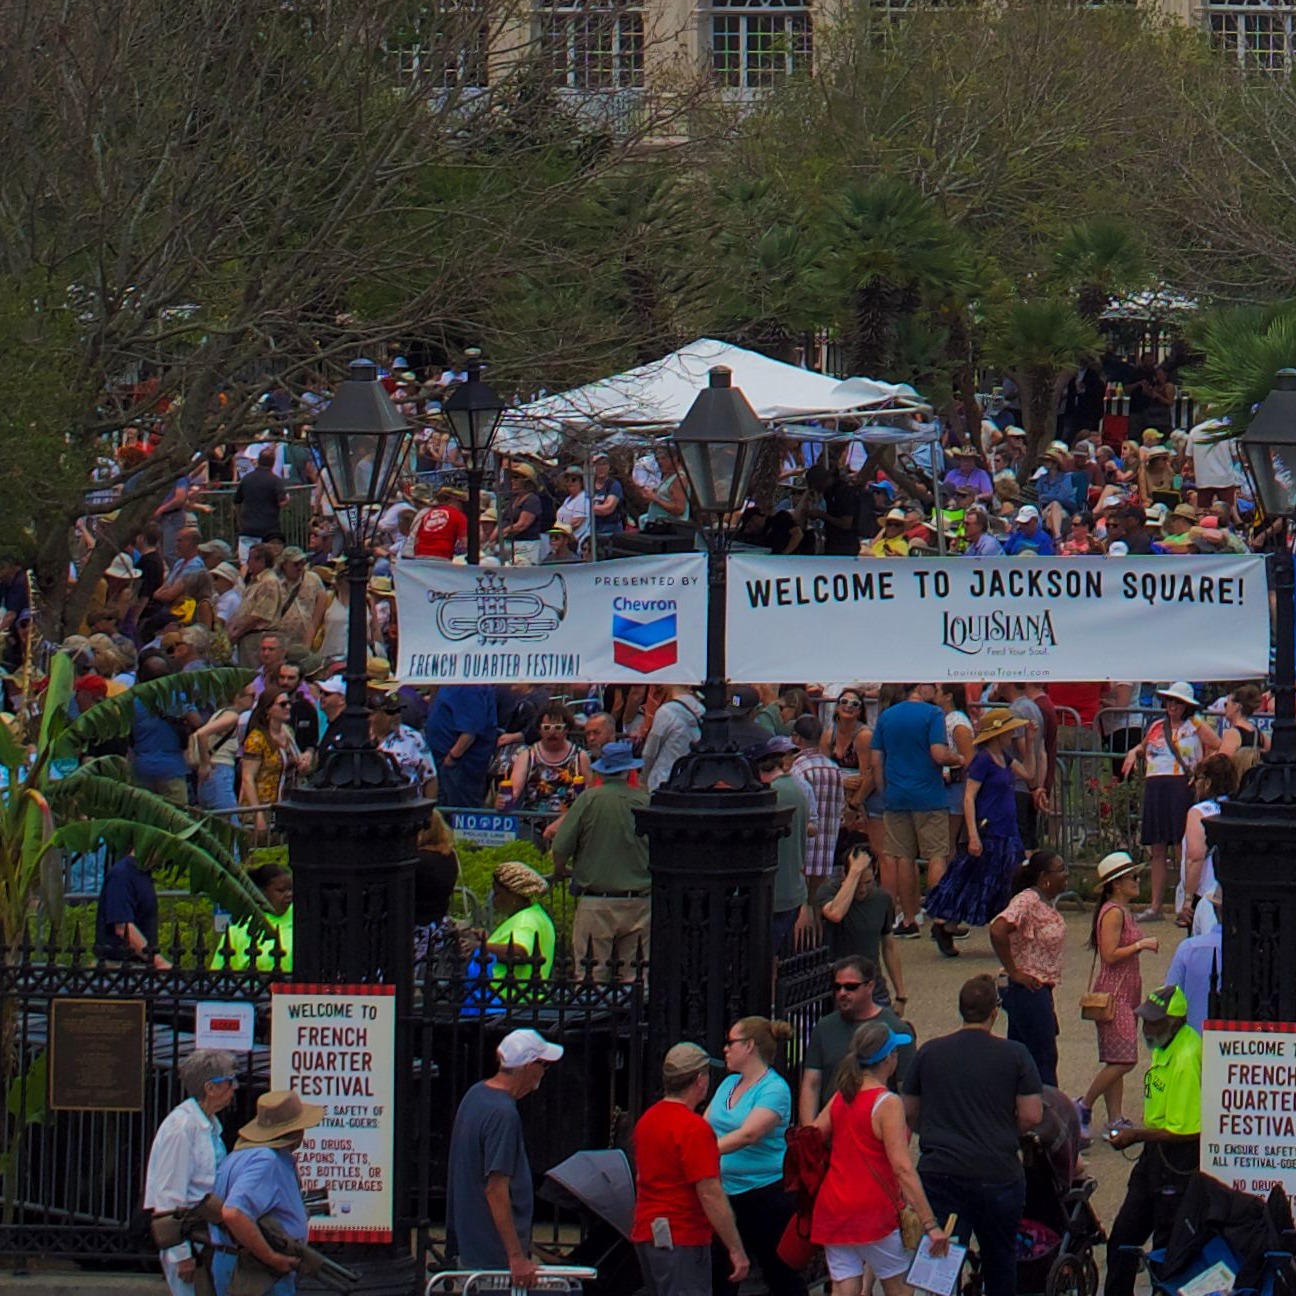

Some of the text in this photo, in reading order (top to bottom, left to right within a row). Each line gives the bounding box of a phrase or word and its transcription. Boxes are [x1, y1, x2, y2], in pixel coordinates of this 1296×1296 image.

[594, 575, 699, 587] PRESENTED BY
[746, 569, 1246, 608] WELCOME TO JACKSON SQUARE!
[612, 596, 677, 612] Chevron
[408, 653, 582, 677] FRENCH QUARTER FESTIVAL
[288, 1003, 378, 1020] WELCOME TO
[297, 1026, 368, 1047] FRENCH
[1219, 1040, 1286, 1056] WELCOME
[291, 1050, 373, 1074] QUARTER
[289, 1075, 375, 1097] FESTIVAL
[334, 1105, 369, 1116] SAFETY
[373, 1106, 385, 1116] OF
[317, 1117, 381, 1128] TIVAL-GOERS:
[302, 1139, 355, 1152] NO DRUGS,
[1208, 1143, 1220, 1154] TO
[1224, 1144, 1259, 1155] ENSURE
[343, 1152, 371, 1165] PETS,
[1212, 1156, 1228, 1167] ALL
[317, 1165, 364, 1179] BOTTLES,
[368, 1166, 382, 1178] OR
[325, 1179, 383, 1192] BEVERAGES
[1232, 1179, 1246, 1191] NO
